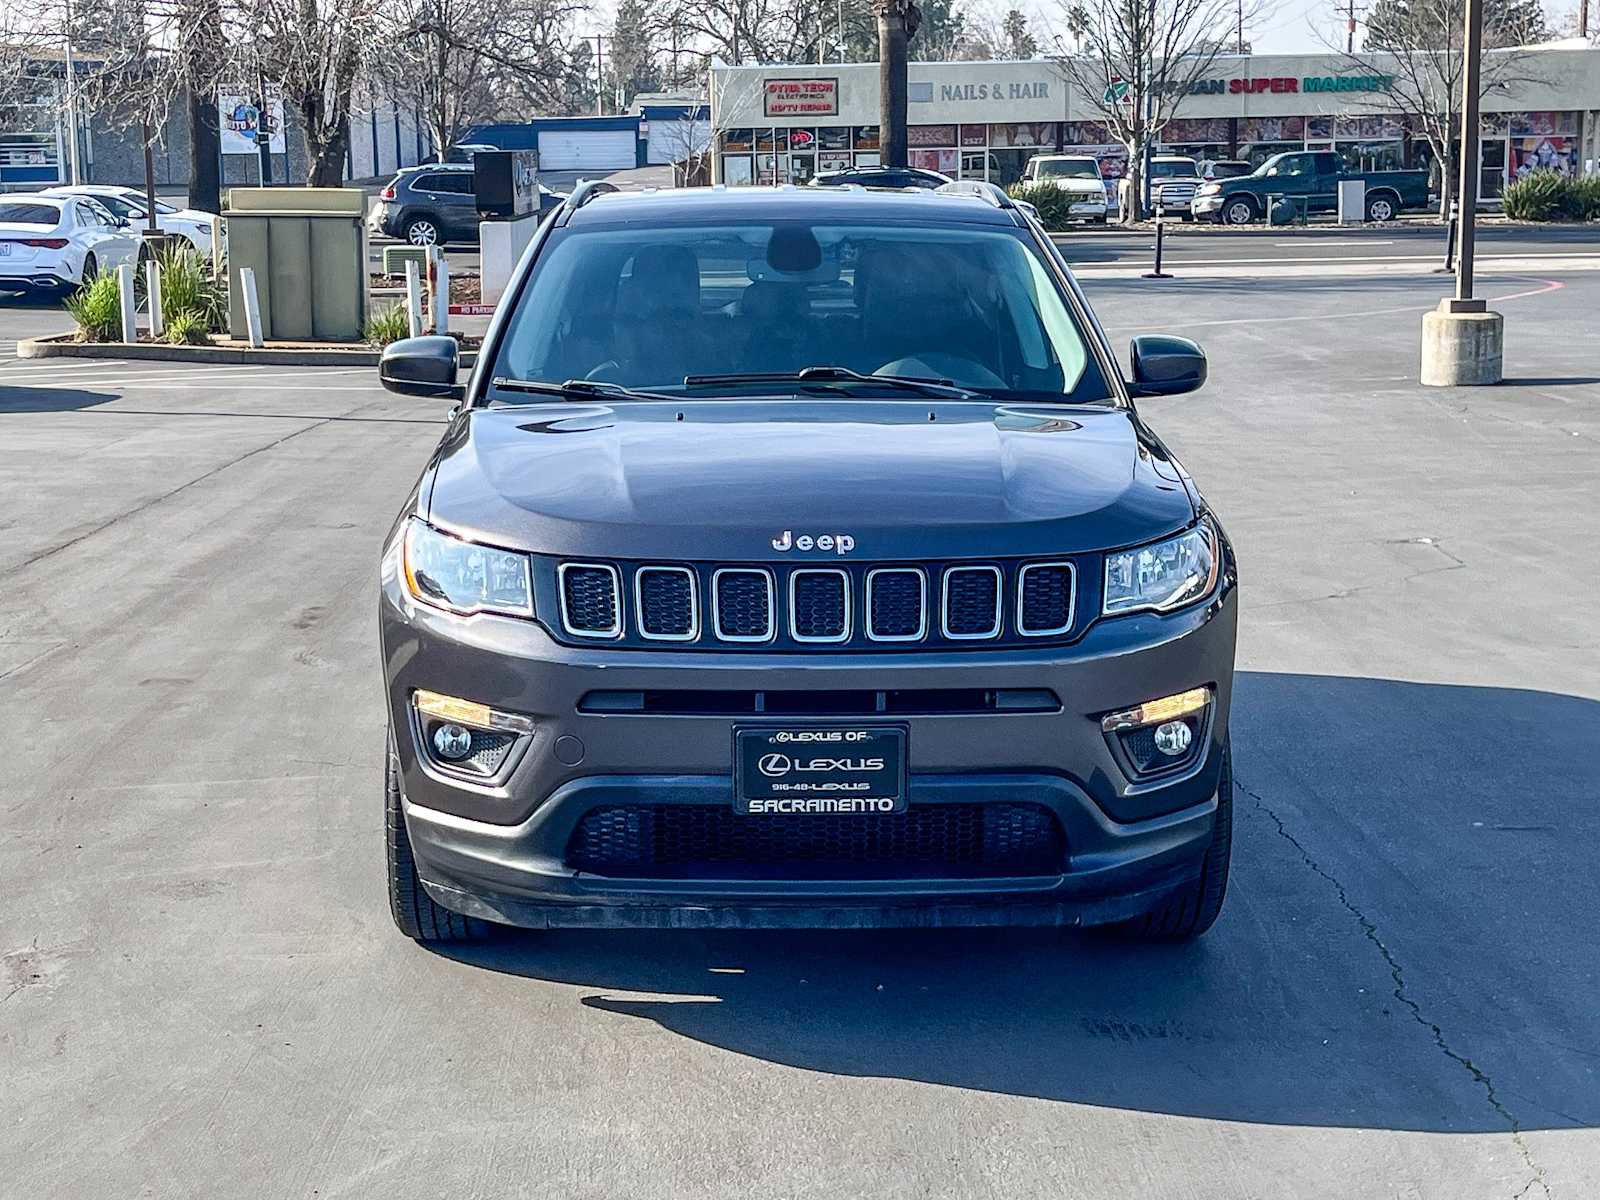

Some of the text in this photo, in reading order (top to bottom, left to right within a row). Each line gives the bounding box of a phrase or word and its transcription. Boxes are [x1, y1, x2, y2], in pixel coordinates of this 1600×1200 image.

[941, 82, 1049, 101] NAILS & HAIR
[1229, 77, 1298, 95] SUPER
[1303, 75, 1393, 93] MARKET
[791, 132, 812, 143] OPEN
[772, 531, 855, 555] Jeep
[789, 731, 867, 742] LEXUS OF
[794, 758, 884, 771] LEXUS
[749, 798, 894, 813] SACRAMENTO
